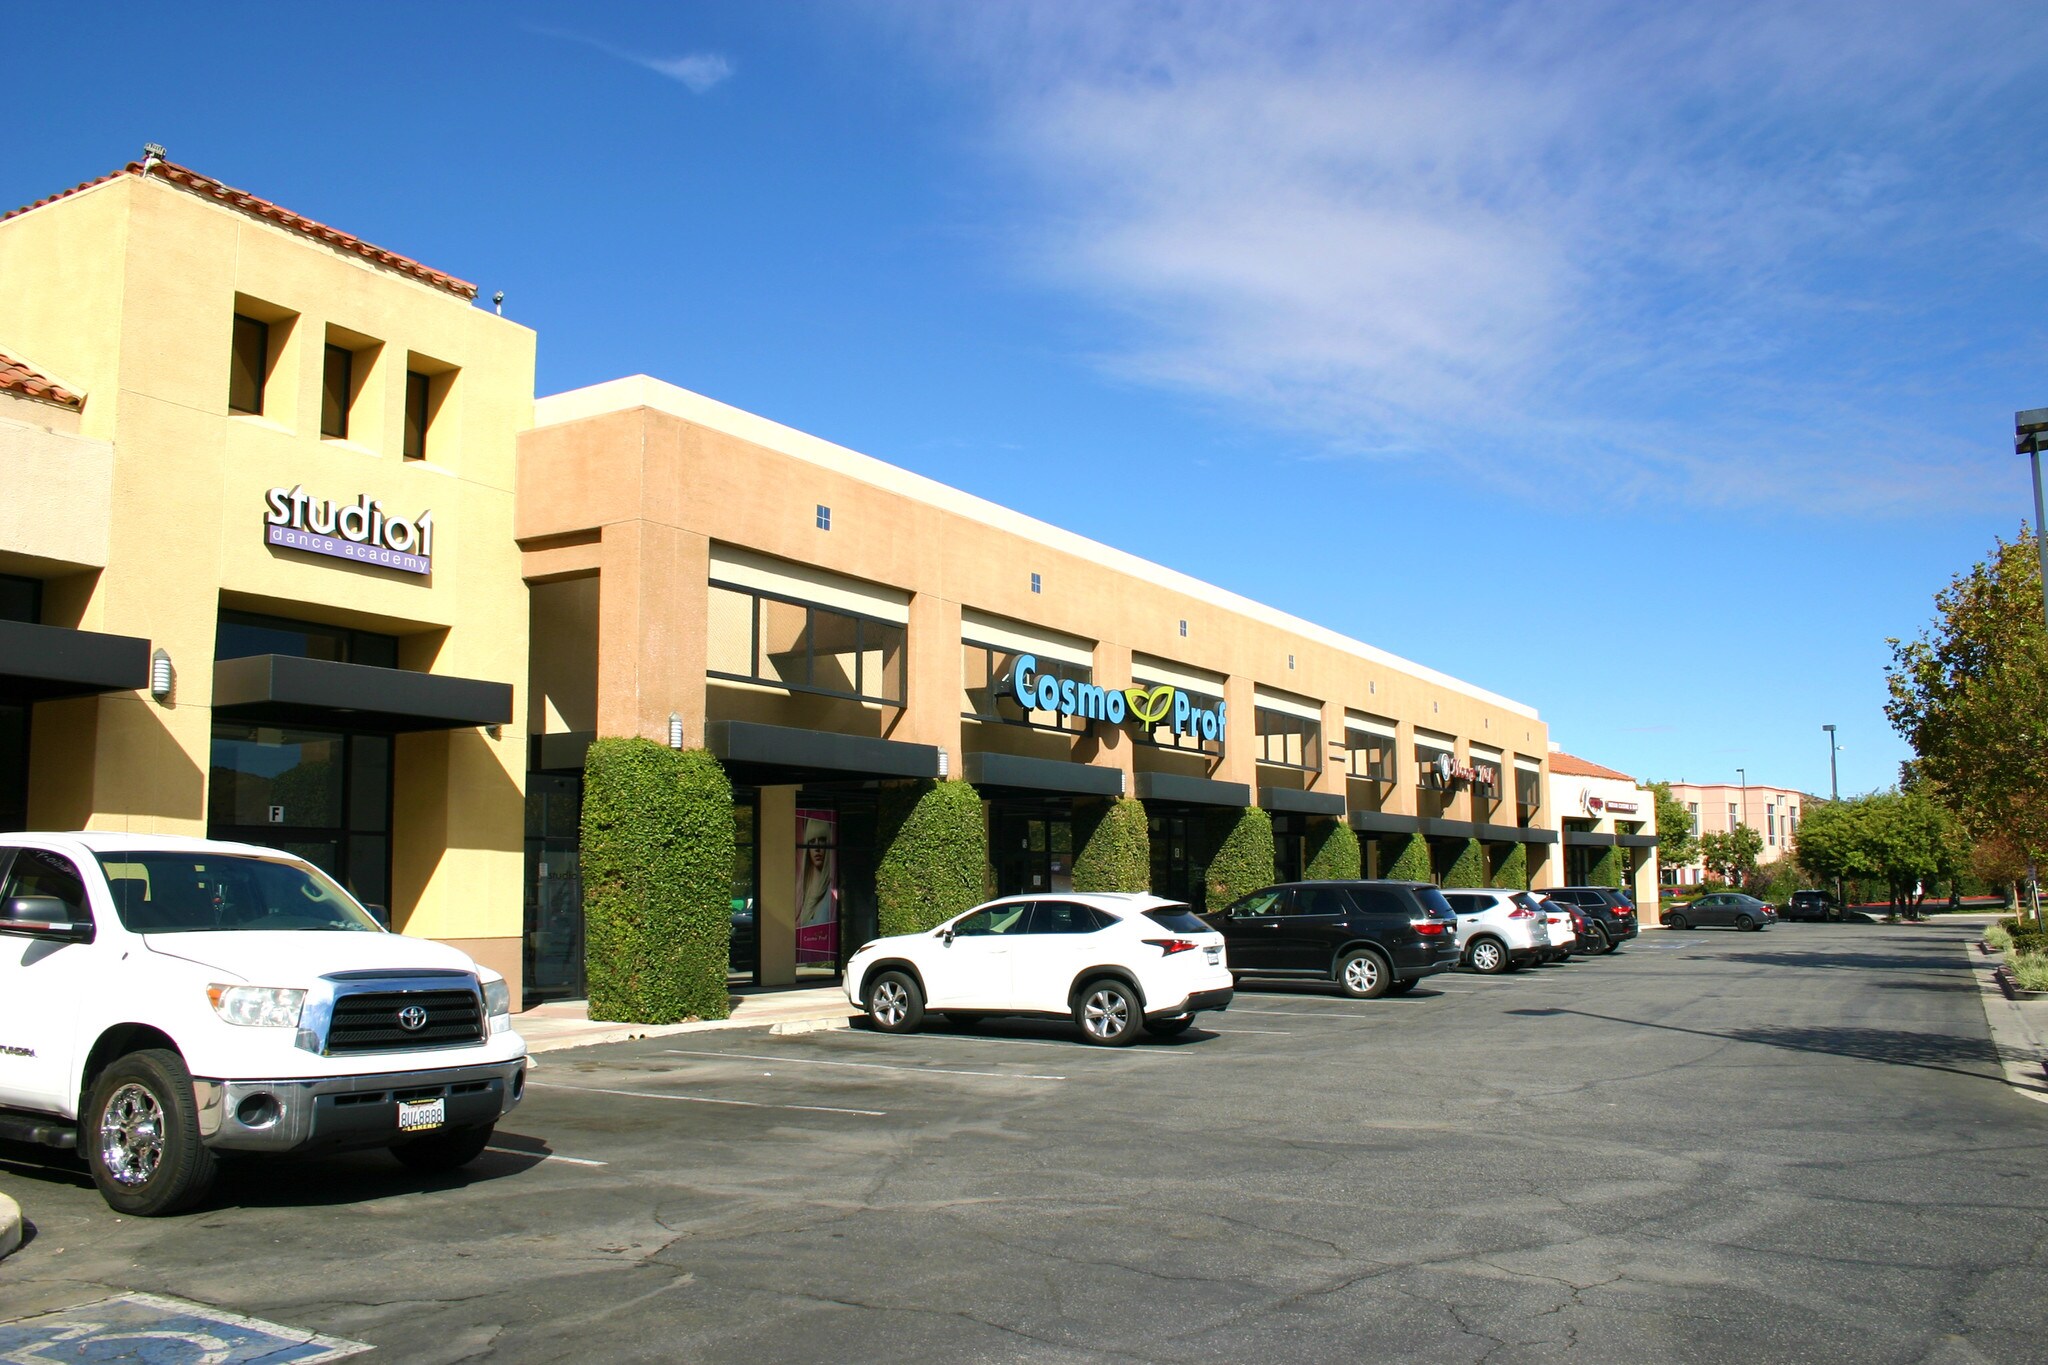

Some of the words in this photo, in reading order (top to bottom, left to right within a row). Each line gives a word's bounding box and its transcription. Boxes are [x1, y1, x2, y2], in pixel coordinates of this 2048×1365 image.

[264, 484, 433, 556] studio1
[272, 527, 333, 551] dance
[345, 543, 428, 572] academy
[1009, 653, 1126, 725] Cosmo
[1173, 690, 1227, 743] Prof
[272, 807, 280, 821] F
[401, 1109, 442, 1127] 8U48888
